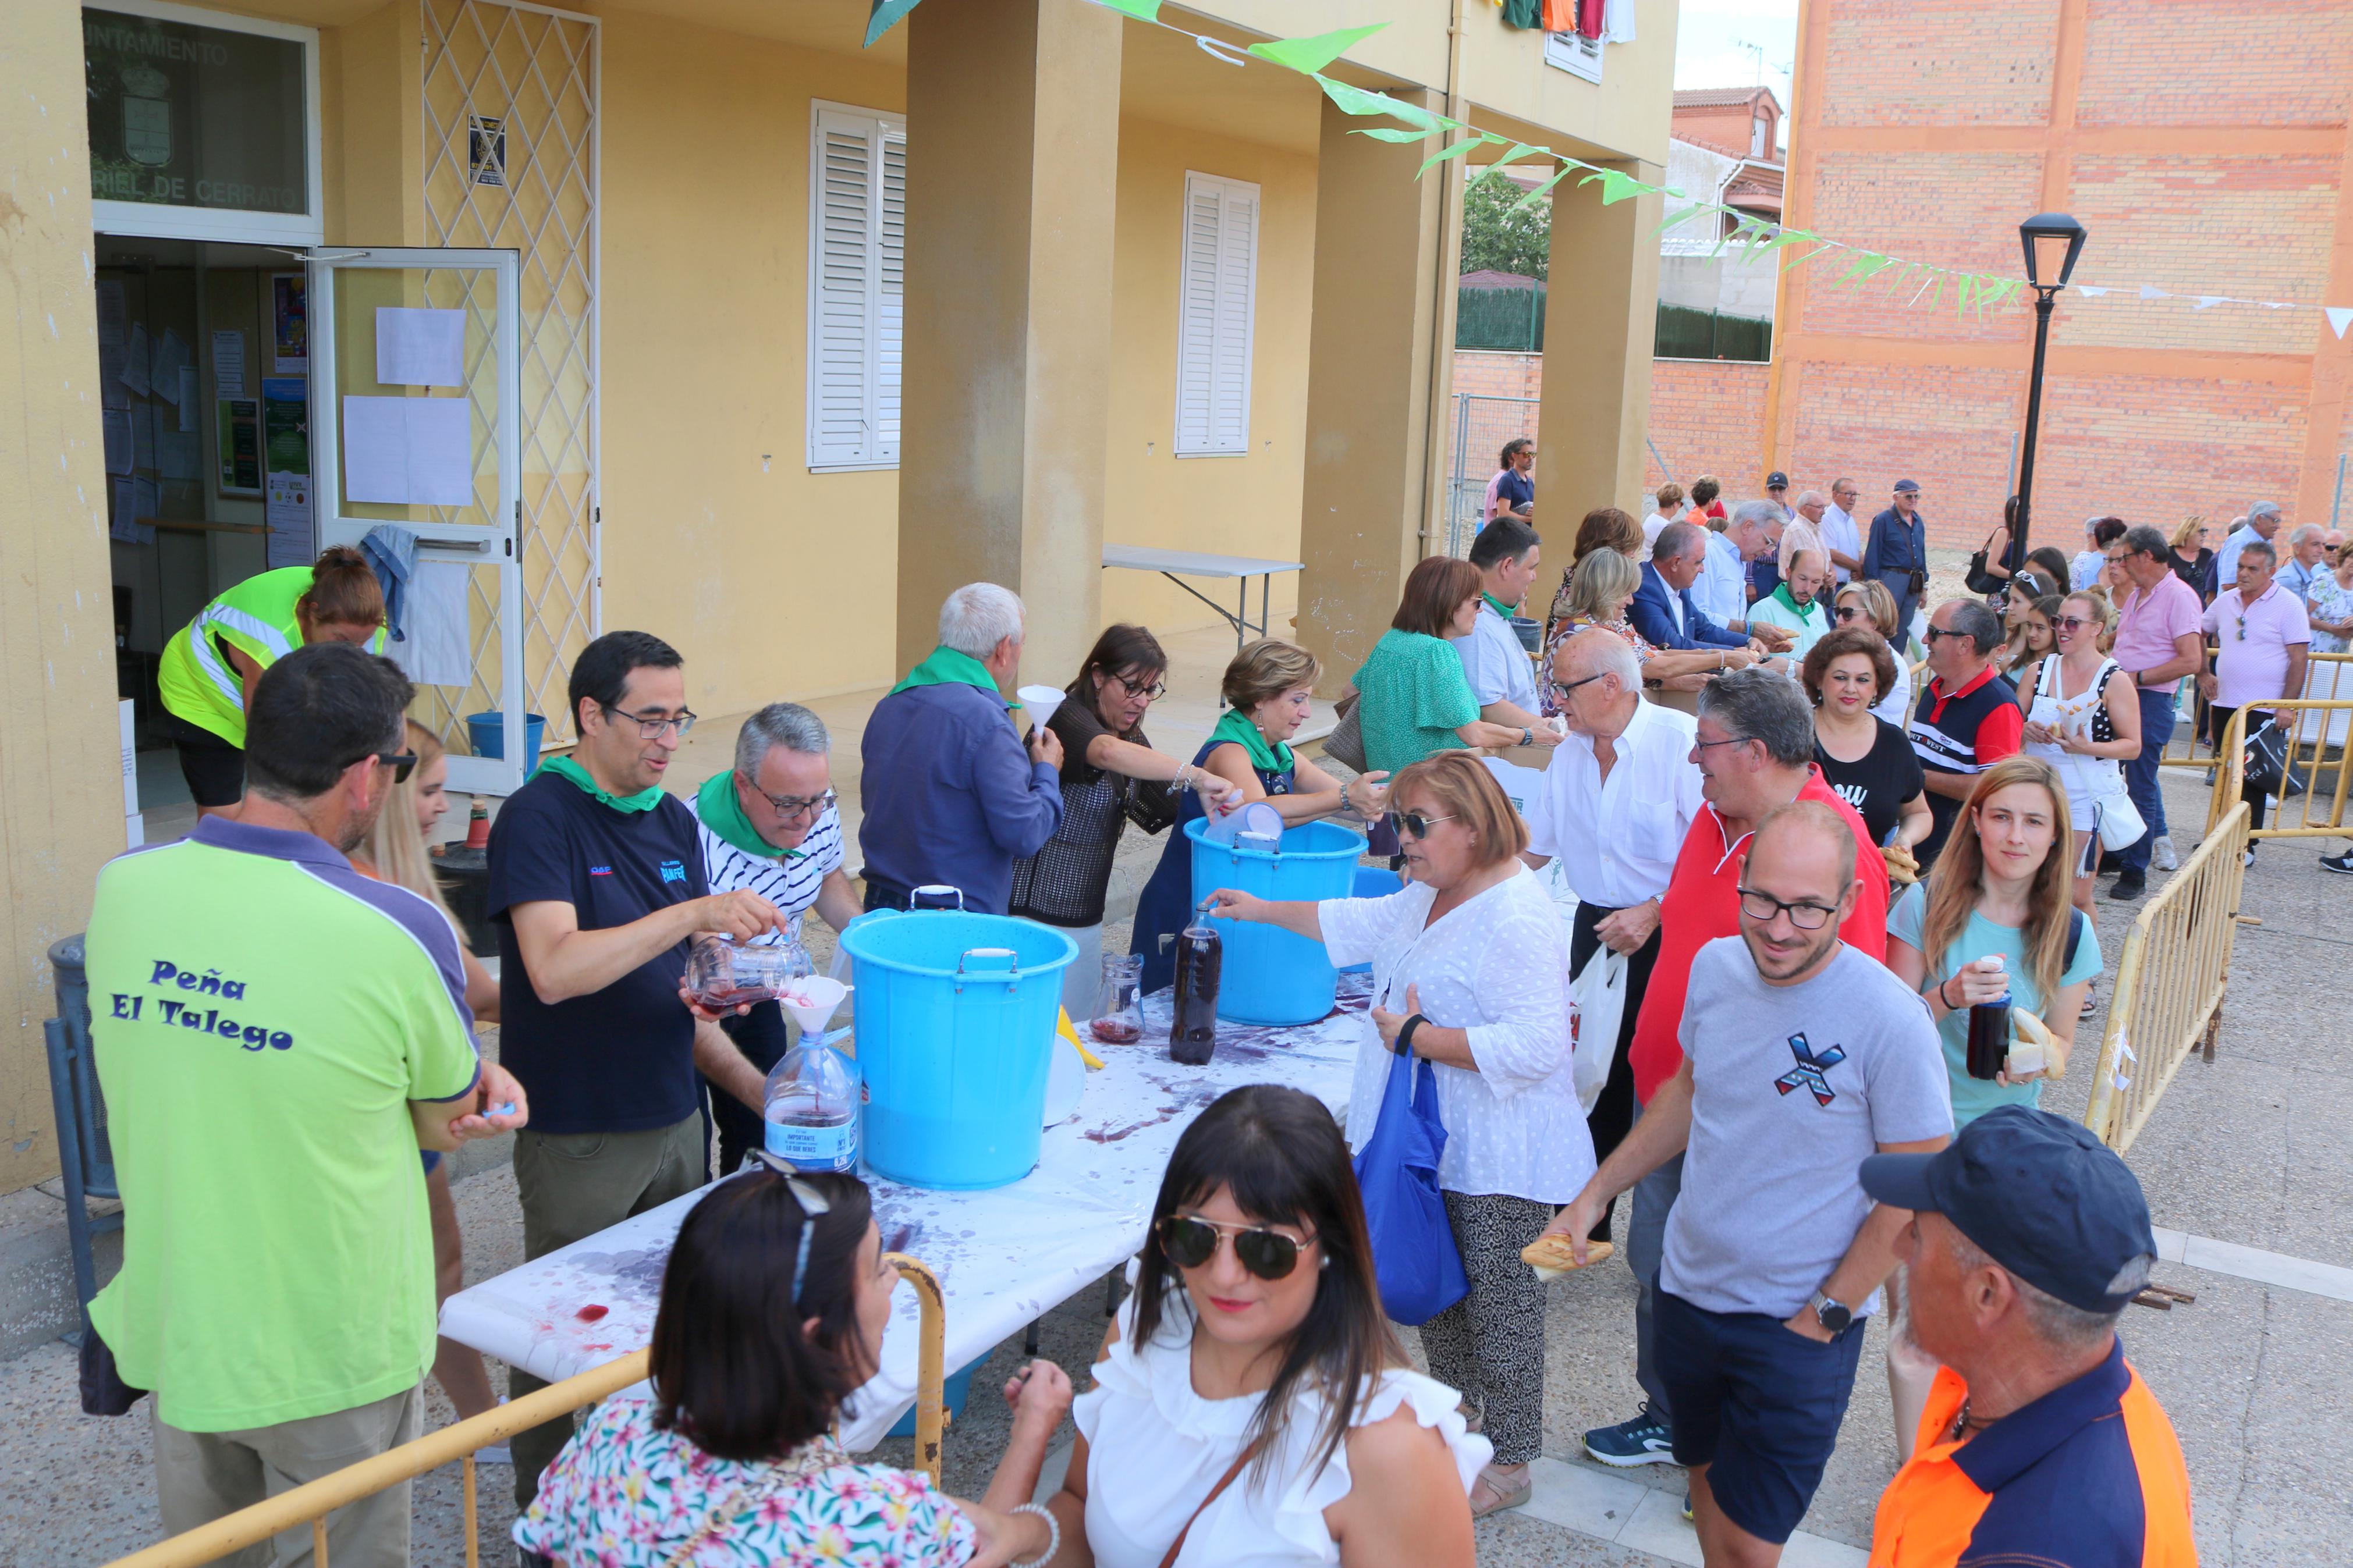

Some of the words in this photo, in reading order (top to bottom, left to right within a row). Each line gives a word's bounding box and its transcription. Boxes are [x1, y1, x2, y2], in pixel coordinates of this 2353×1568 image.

[154, 175, 186, 200] DE
[196, 179, 296, 209] CERRATO
[148, 959, 247, 1001] Peña
[109, 993, 143, 1021] El
[158, 999, 293, 1052] Talego
[787, 1133, 815, 1142] IMPORTANTE
